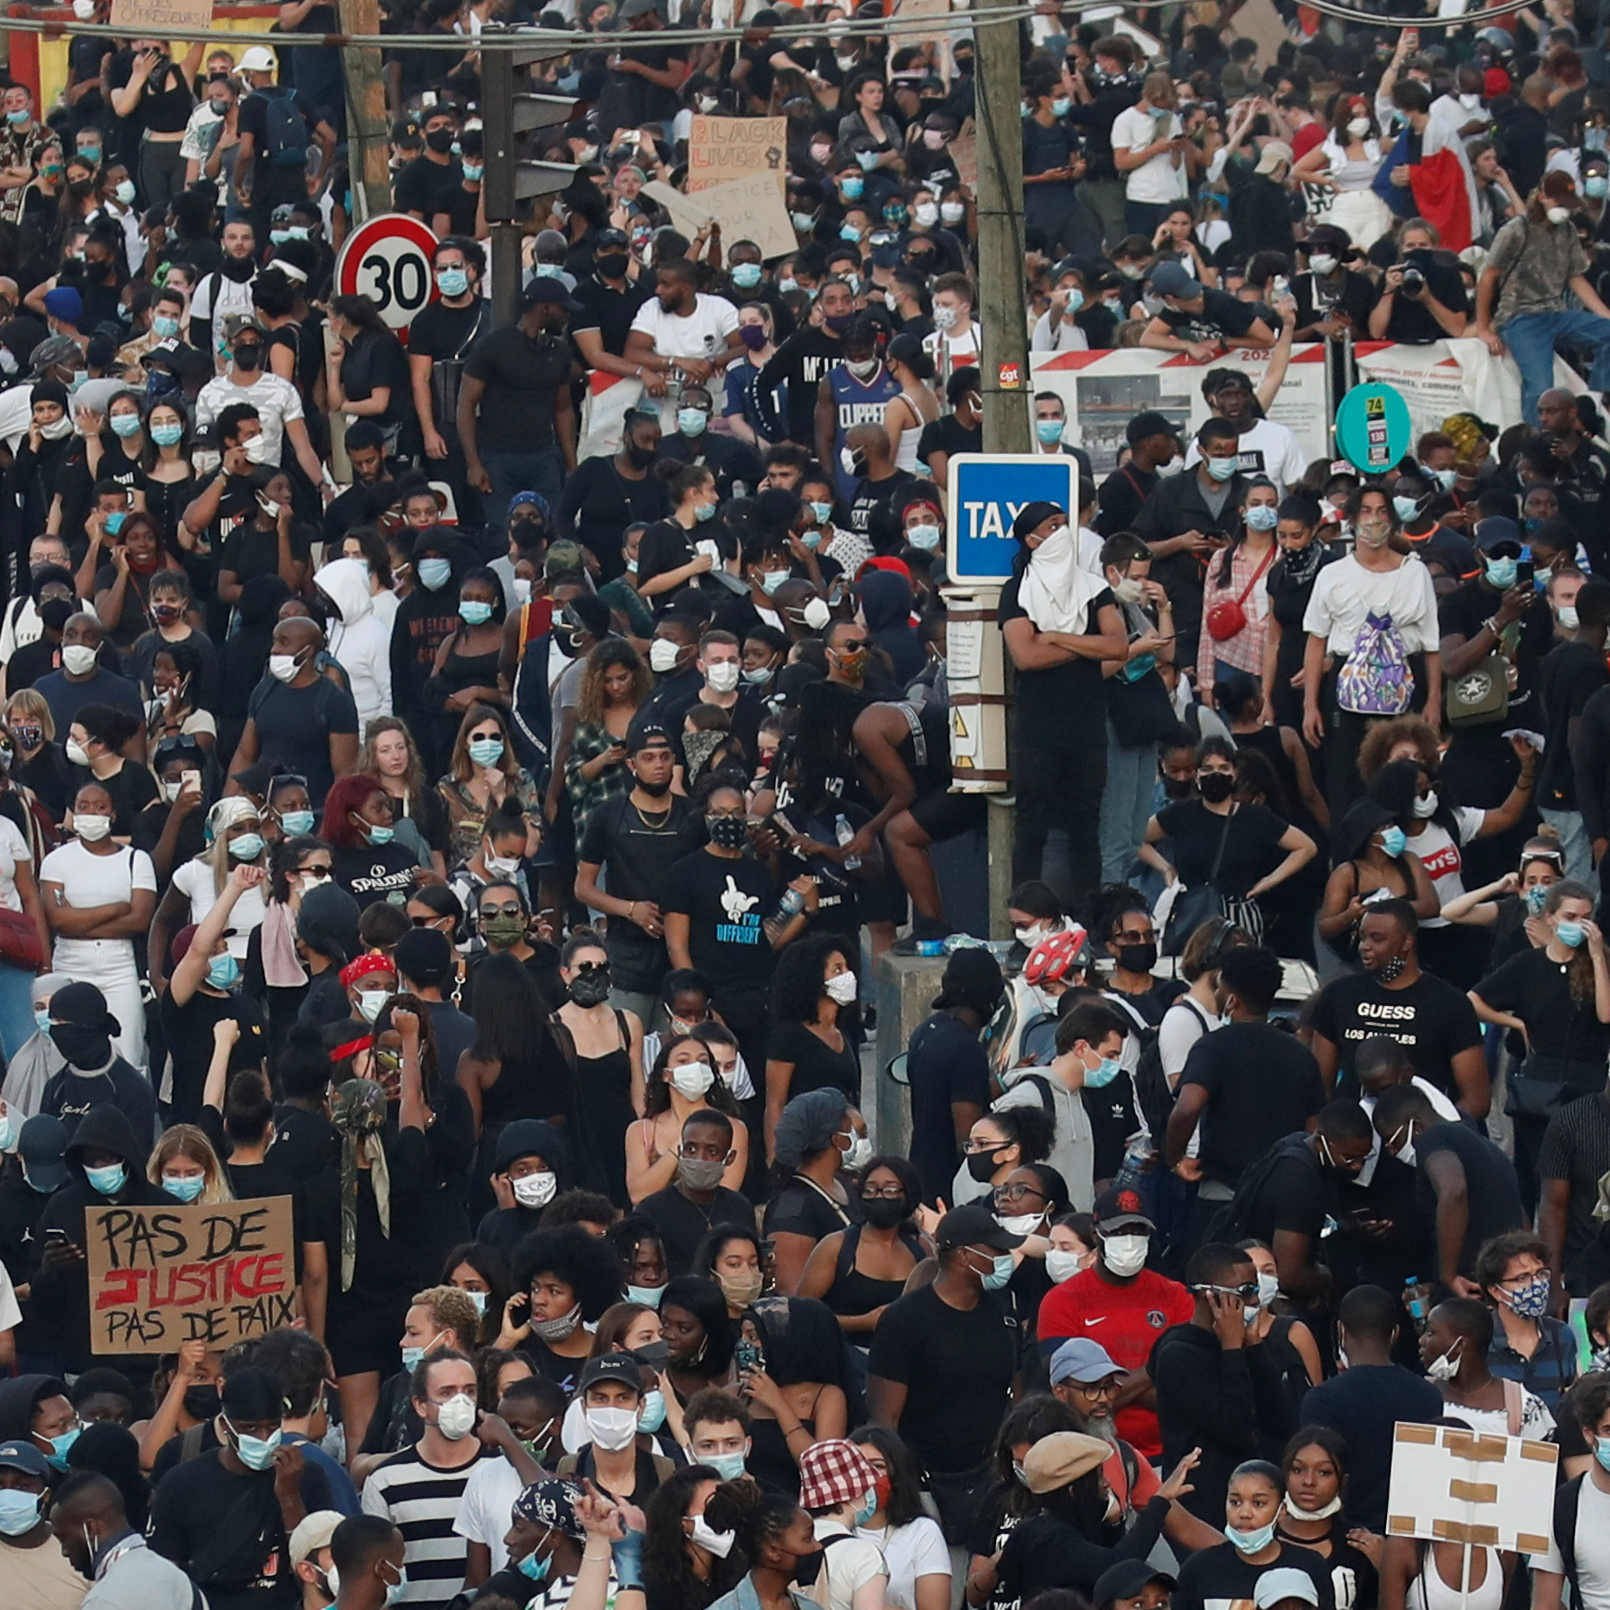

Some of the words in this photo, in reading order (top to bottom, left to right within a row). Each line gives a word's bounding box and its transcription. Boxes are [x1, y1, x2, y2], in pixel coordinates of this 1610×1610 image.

[693, 120, 785, 146] BLACK
[362, 252, 428, 311] 30
[1368, 399, 1383, 412] 74
[964, 501, 1031, 540] TAX
[716, 923, 762, 945] DIFFERENT
[1357, 1002, 1417, 1020] GUESS
[1345, 1028, 1363, 1042] LOS
[98, 1209, 187, 1269] PAS
[202, 1208, 269, 1263] DE
[95, 1253, 286, 1311] JUSTICE
[105, 1308, 166, 1345] PAS
[183, 1310, 230, 1341] DE
[232, 1292, 297, 1336] PAIX
